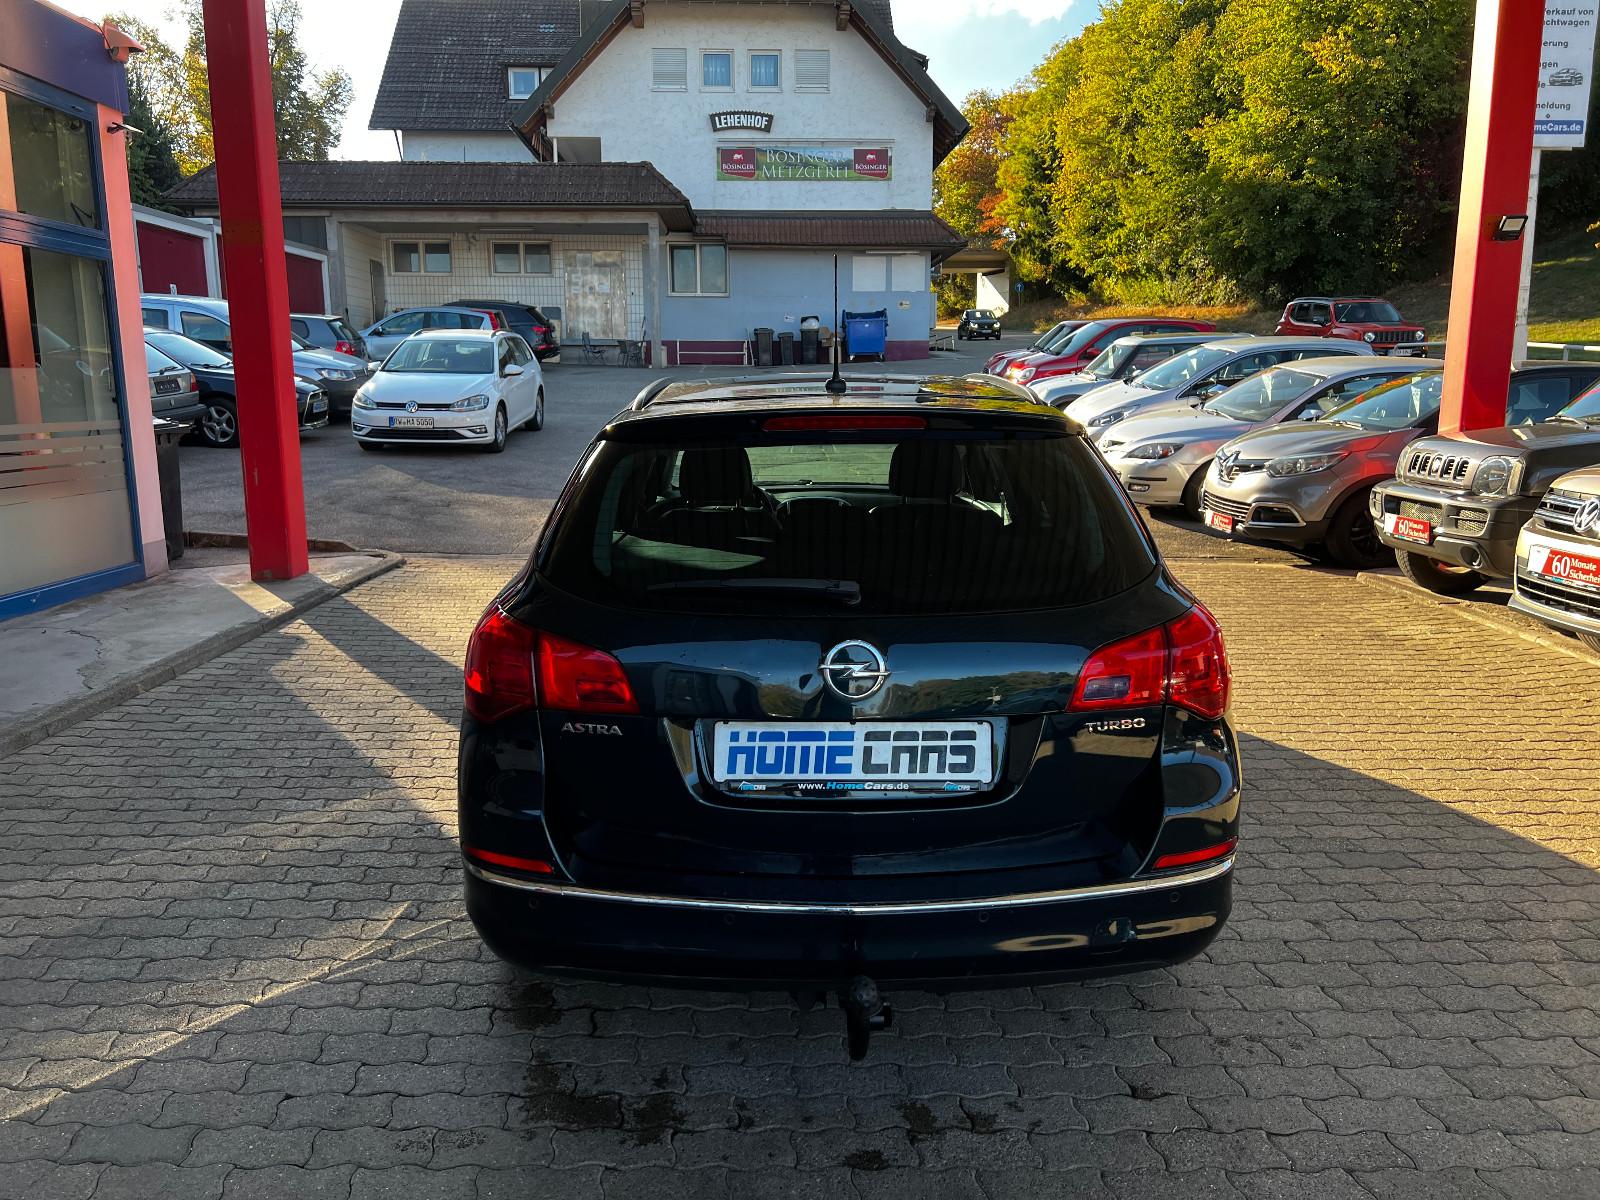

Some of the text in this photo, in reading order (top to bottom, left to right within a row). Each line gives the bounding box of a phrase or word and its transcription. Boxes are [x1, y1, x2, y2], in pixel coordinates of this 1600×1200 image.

[1544, 8, 1576, 16] erkauf
[1543, 19, 1590, 28] chtwagen
[715, 114, 769, 129] LEHENHOF
[762, 165, 848, 178] METZGEREI
[1398, 519, 1409, 534] 60
[1551, 555, 1571, 577] 60
[1570, 558, 1597, 571] Monate
[561, 722, 623, 736] ASTRA
[1084, 718, 1146, 732] TURBO
[727, 730, 978, 775] HOME CARS
[797, 781, 910, 790] www.HomeCars.de
